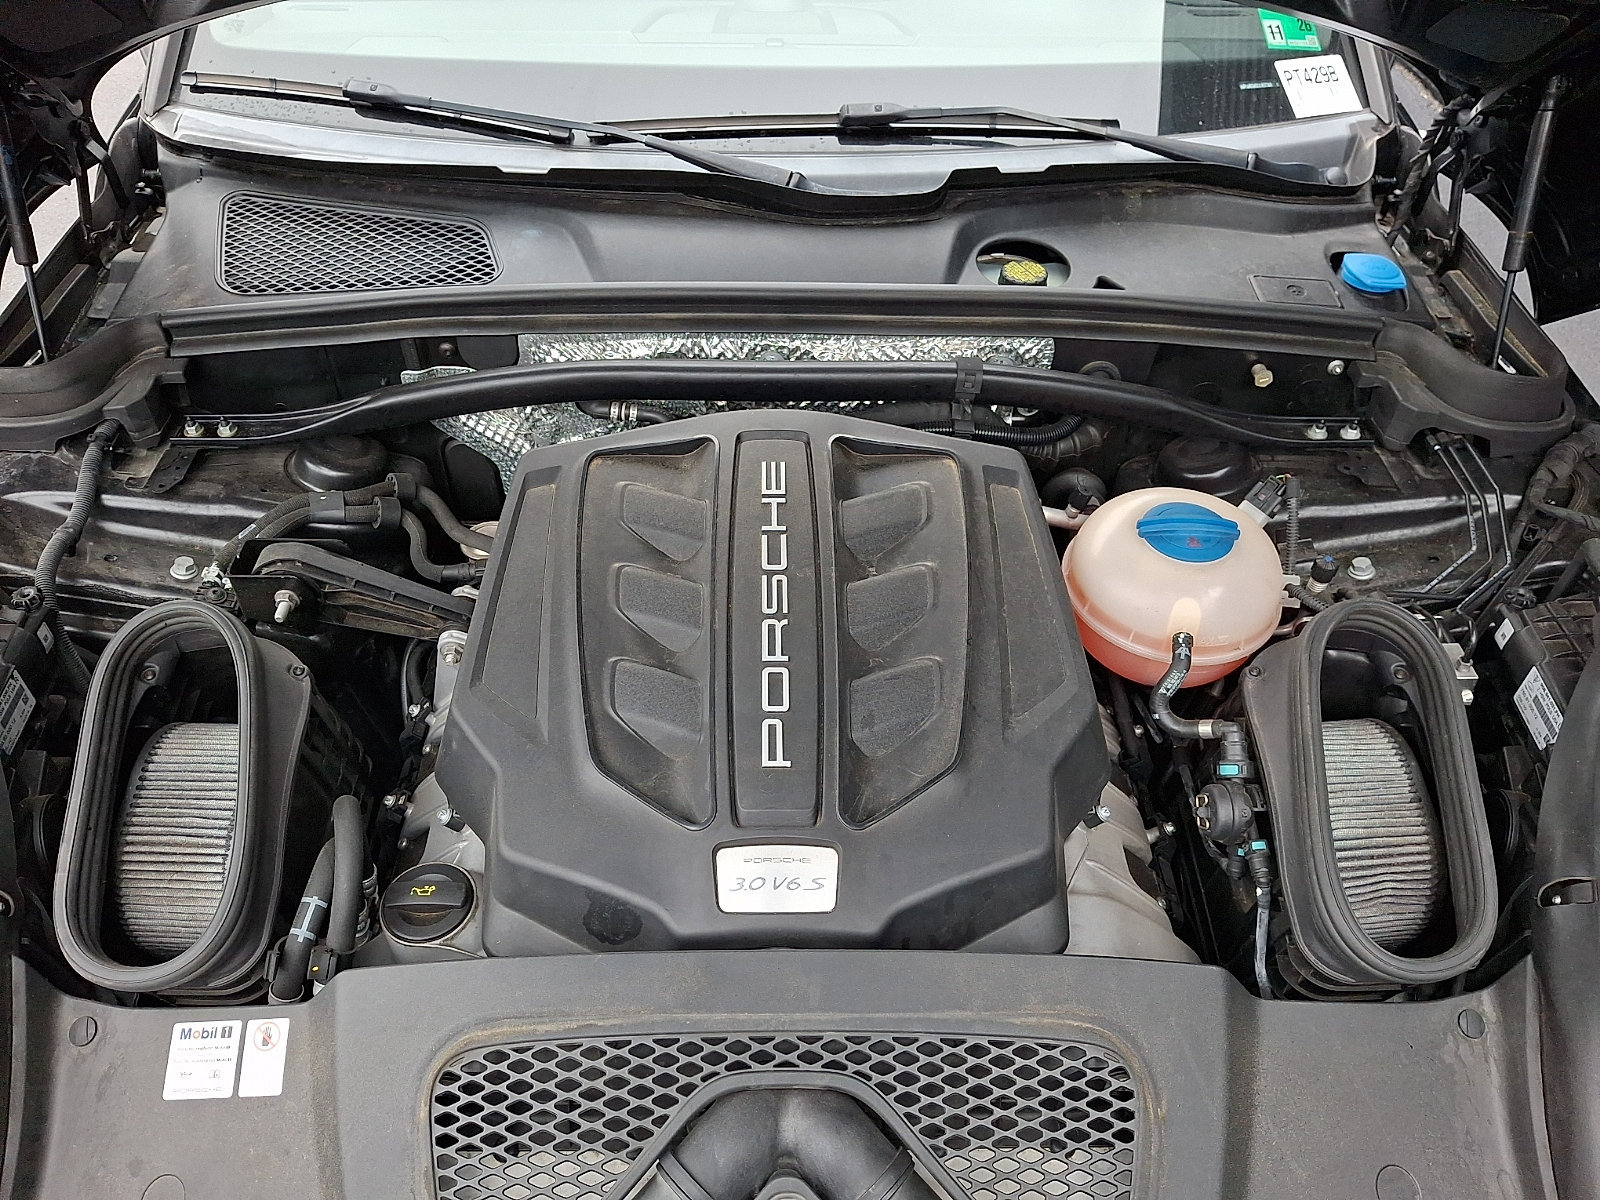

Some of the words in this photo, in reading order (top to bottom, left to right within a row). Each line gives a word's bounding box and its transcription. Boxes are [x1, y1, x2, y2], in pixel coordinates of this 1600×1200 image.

[1267, 24, 1284, 40] 11
[761, 461, 792, 768] PORSCHE
[729, 877, 766, 891] 3.0
[773, 876, 801, 890] V6
[803, 877, 827, 890] S
[180, 1026, 218, 1040] Mobil
[221, 1026, 233, 1039] 1
